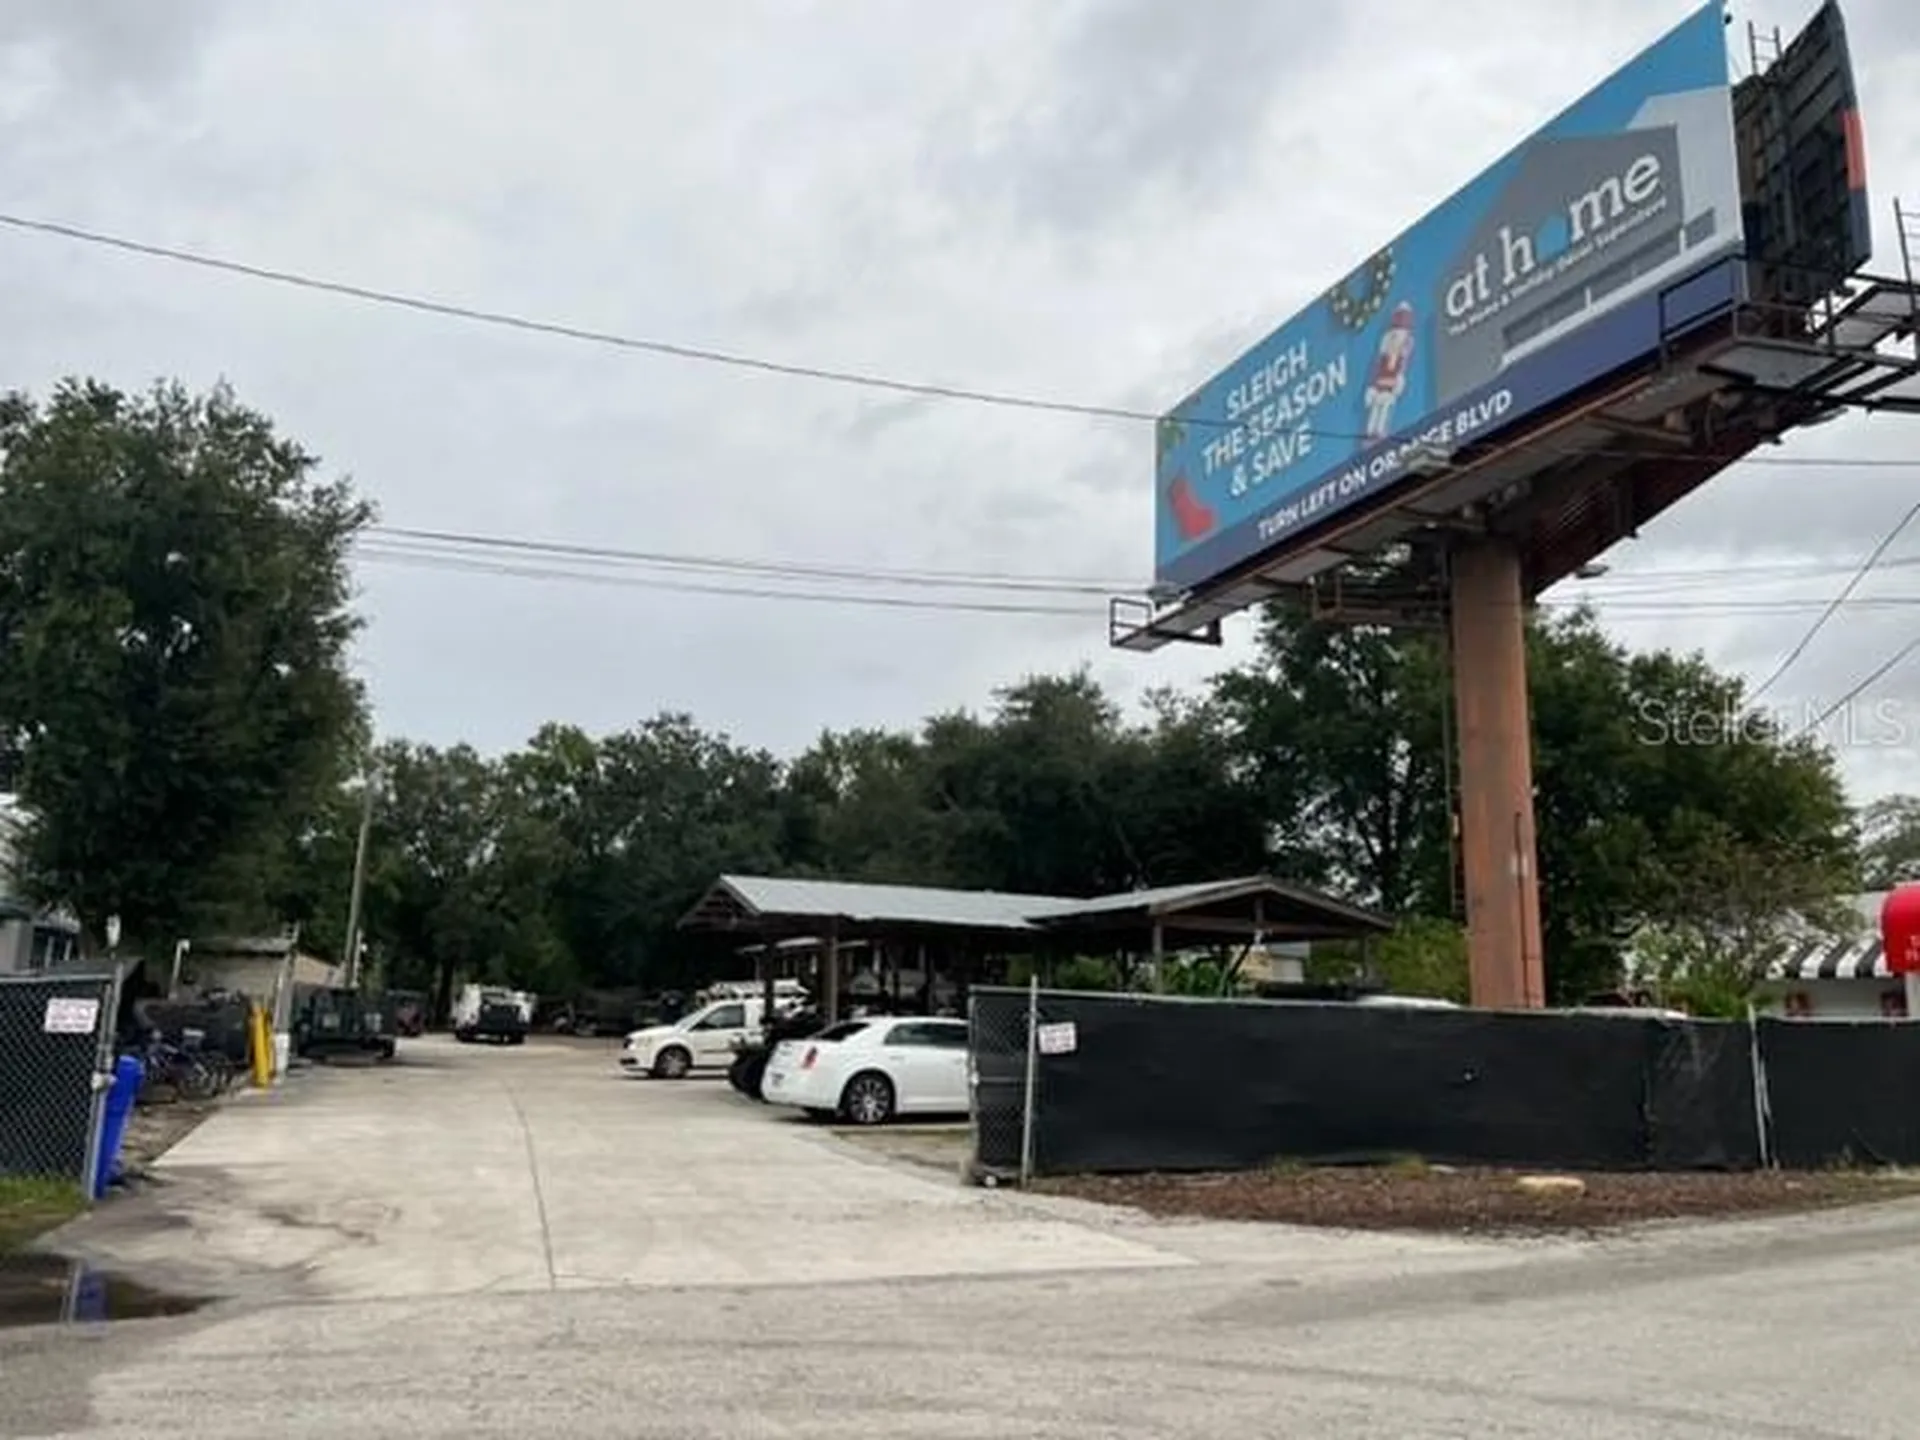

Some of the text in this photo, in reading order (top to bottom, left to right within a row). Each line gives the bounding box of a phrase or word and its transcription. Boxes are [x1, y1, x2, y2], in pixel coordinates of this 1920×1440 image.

[1446, 251, 1491, 319] at
[1202, 353, 1347, 477] THE SEASON
[1226, 337, 1307, 421] SLEIGH
[1230, 419, 1312, 497] & SAVE
[1257, 502, 1300, 541] TURN
[1300, 480, 1337, 518] LEFT
[1339, 464, 1367, 496] ON
[1455, 388, 1513, 437] BLVD
